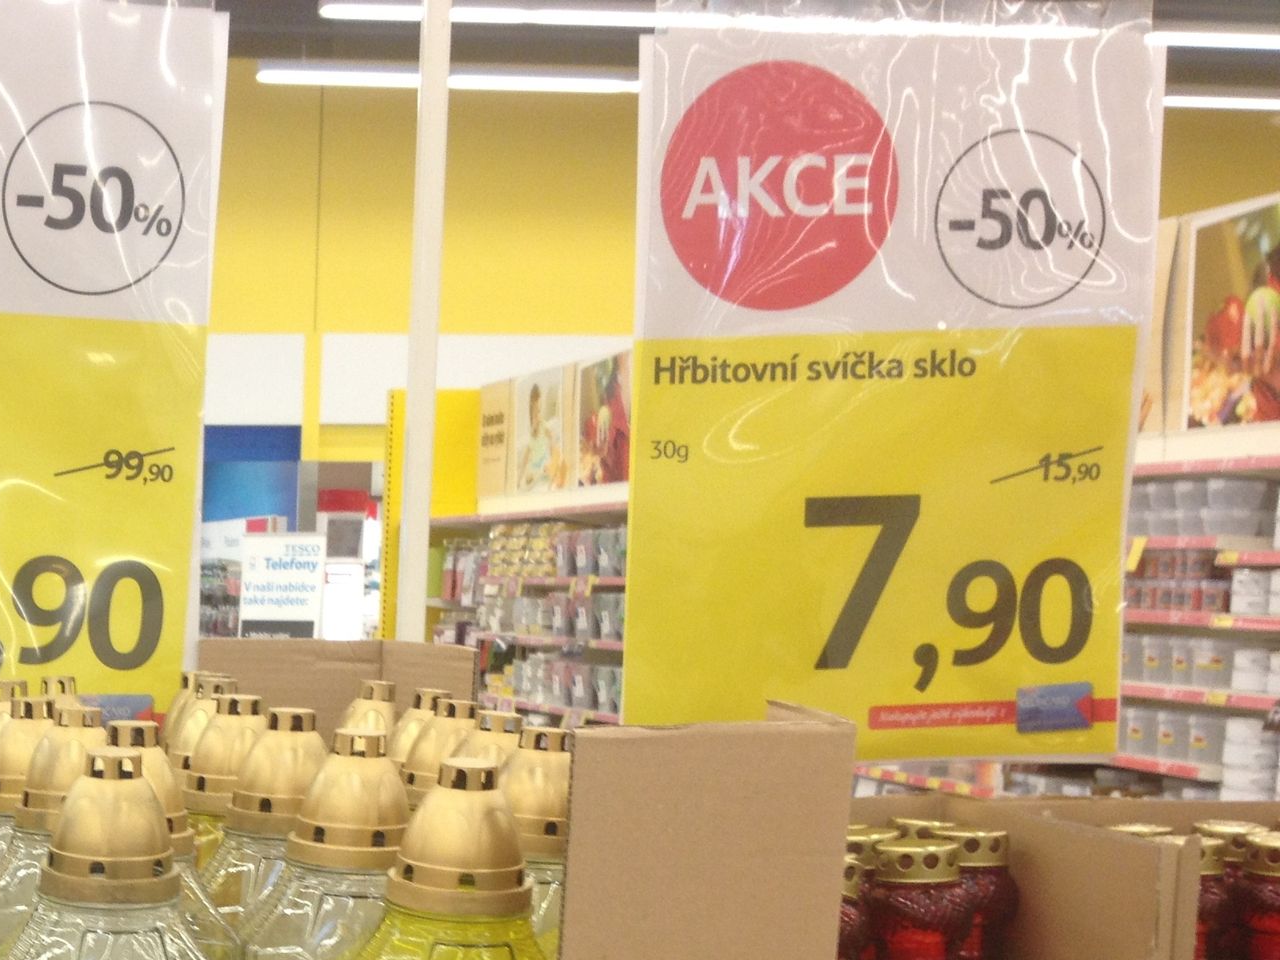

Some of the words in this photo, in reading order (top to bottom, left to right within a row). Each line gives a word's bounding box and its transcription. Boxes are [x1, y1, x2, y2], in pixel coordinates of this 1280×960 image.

[16, 163, 173, 238] -50%
[682, 153, 874, 219] AKCE
[948, 186, 1095, 252] -50%
[652, 354, 800, 386] Hřbitovní
[807, 351, 904, 382] svíčka
[913, 350, 977, 378] sklo
[103, 449, 174, 484] 99,90
[649, 440, 689, 463] 30g
[1038, 452, 1101, 486] 15,90
[264, 557, 318, 574] Telefony
[804, 493, 1094, 694] 7,90
